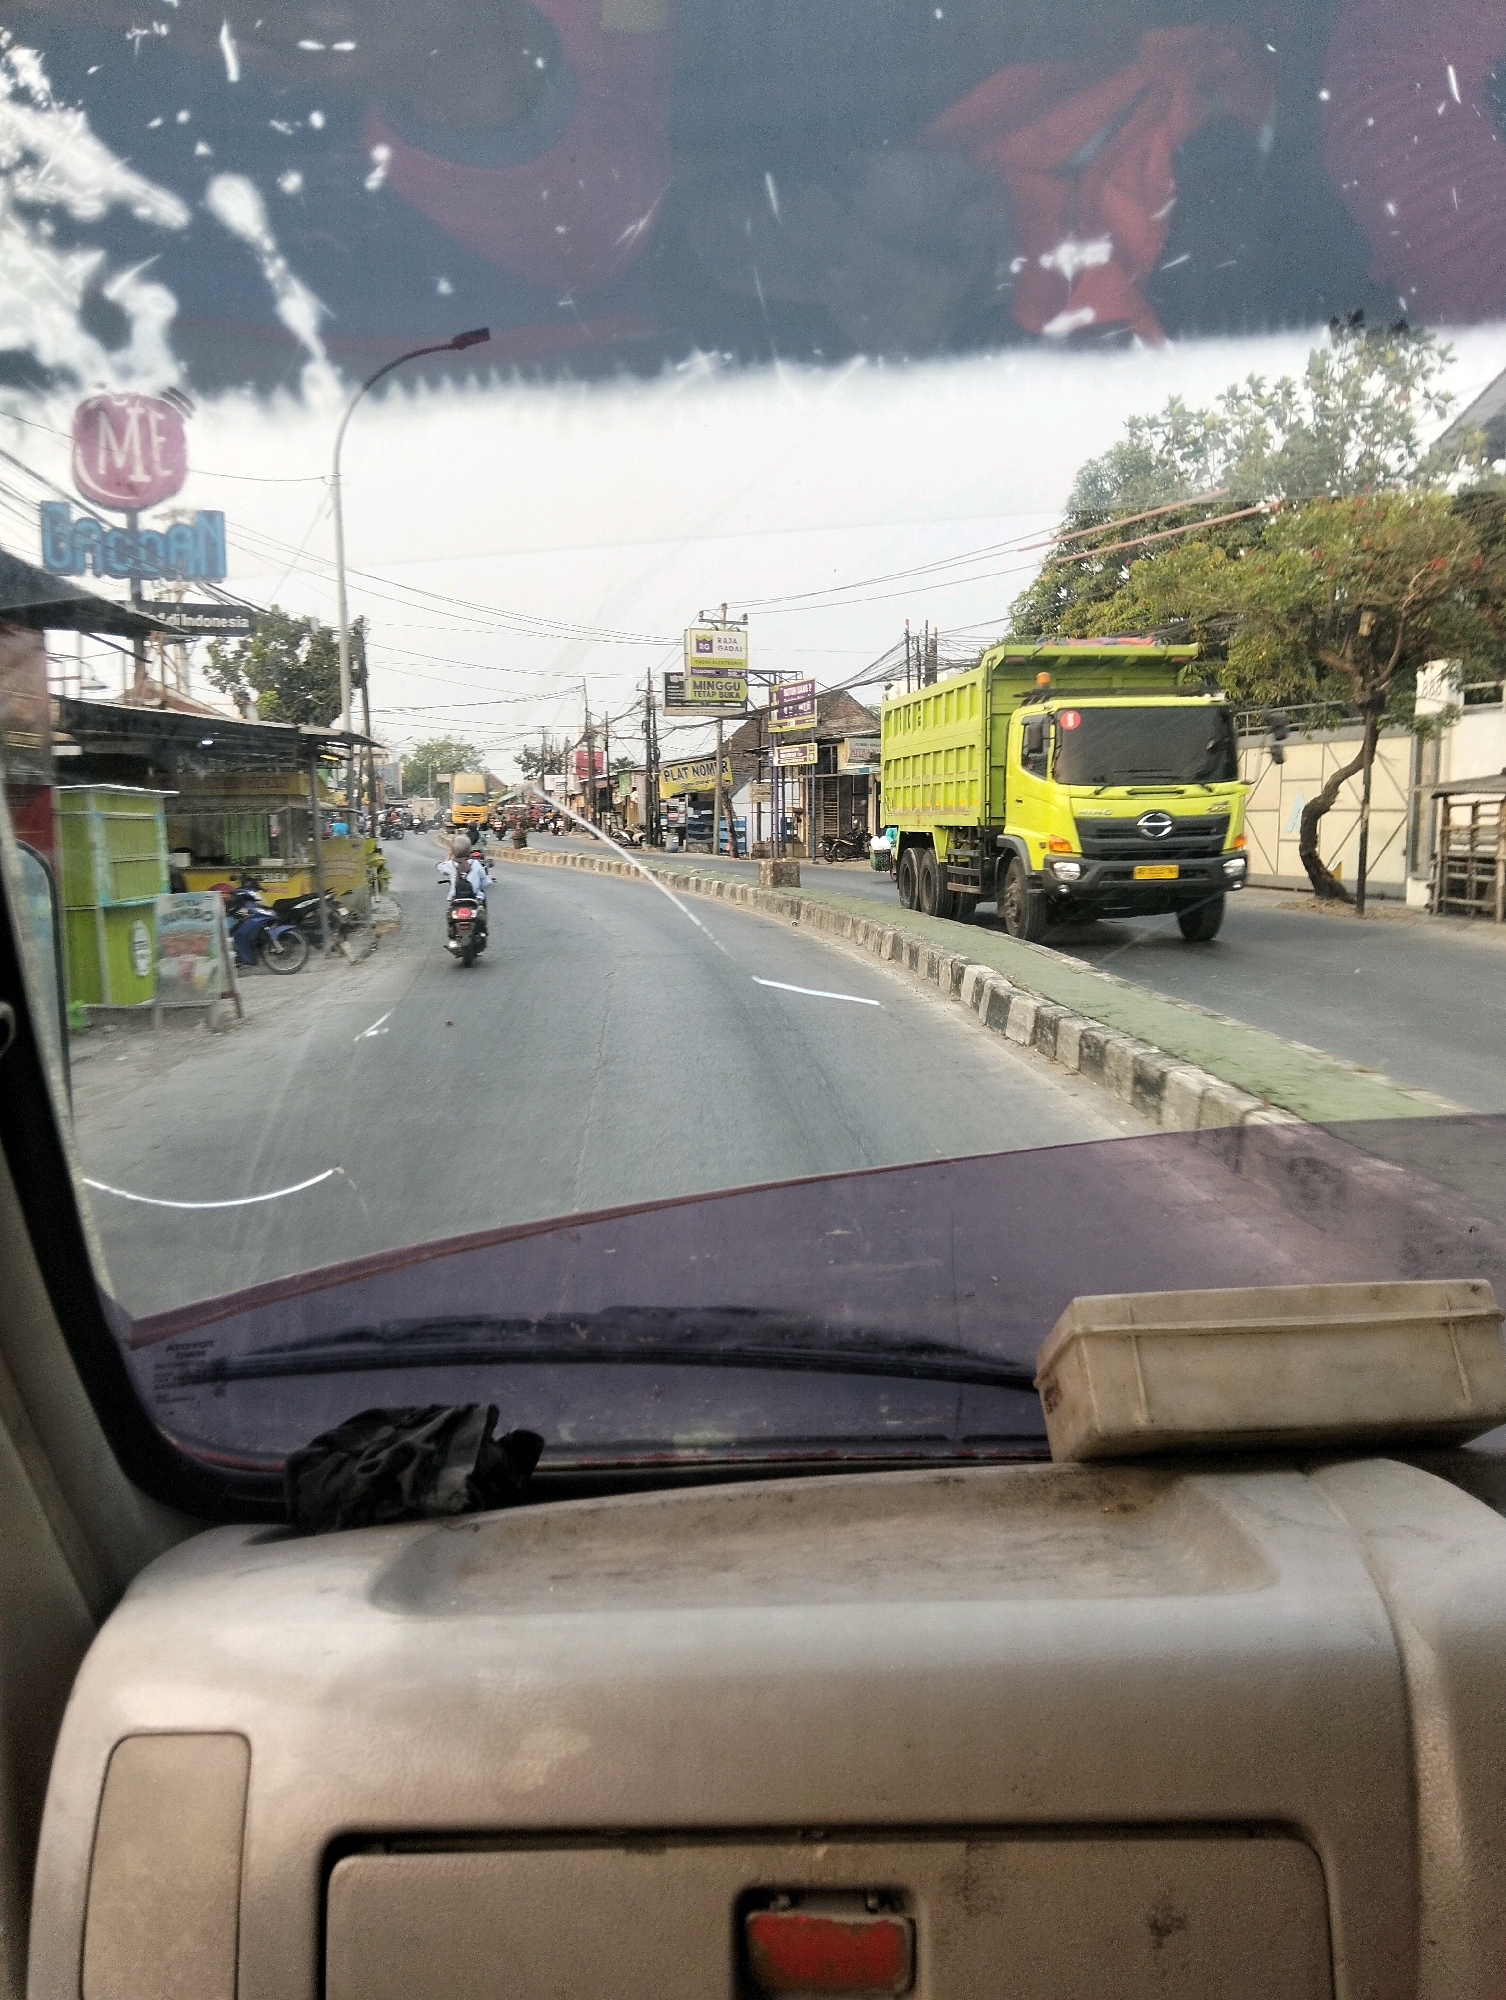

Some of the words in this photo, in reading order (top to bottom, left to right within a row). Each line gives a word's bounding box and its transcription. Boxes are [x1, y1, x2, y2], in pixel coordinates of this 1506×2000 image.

[181, 613, 250, 628] Indonesia
[717, 637, 738, 645] RAJA
[717, 645, 743, 653] GADAI
[692, 680, 741, 691] MINGGU
[693, 690, 717, 698] TETAP
[719, 691, 741, 699] BUKA
[663, 766, 689, 783] PLAT
[691, 760, 729, 777] NOMR
